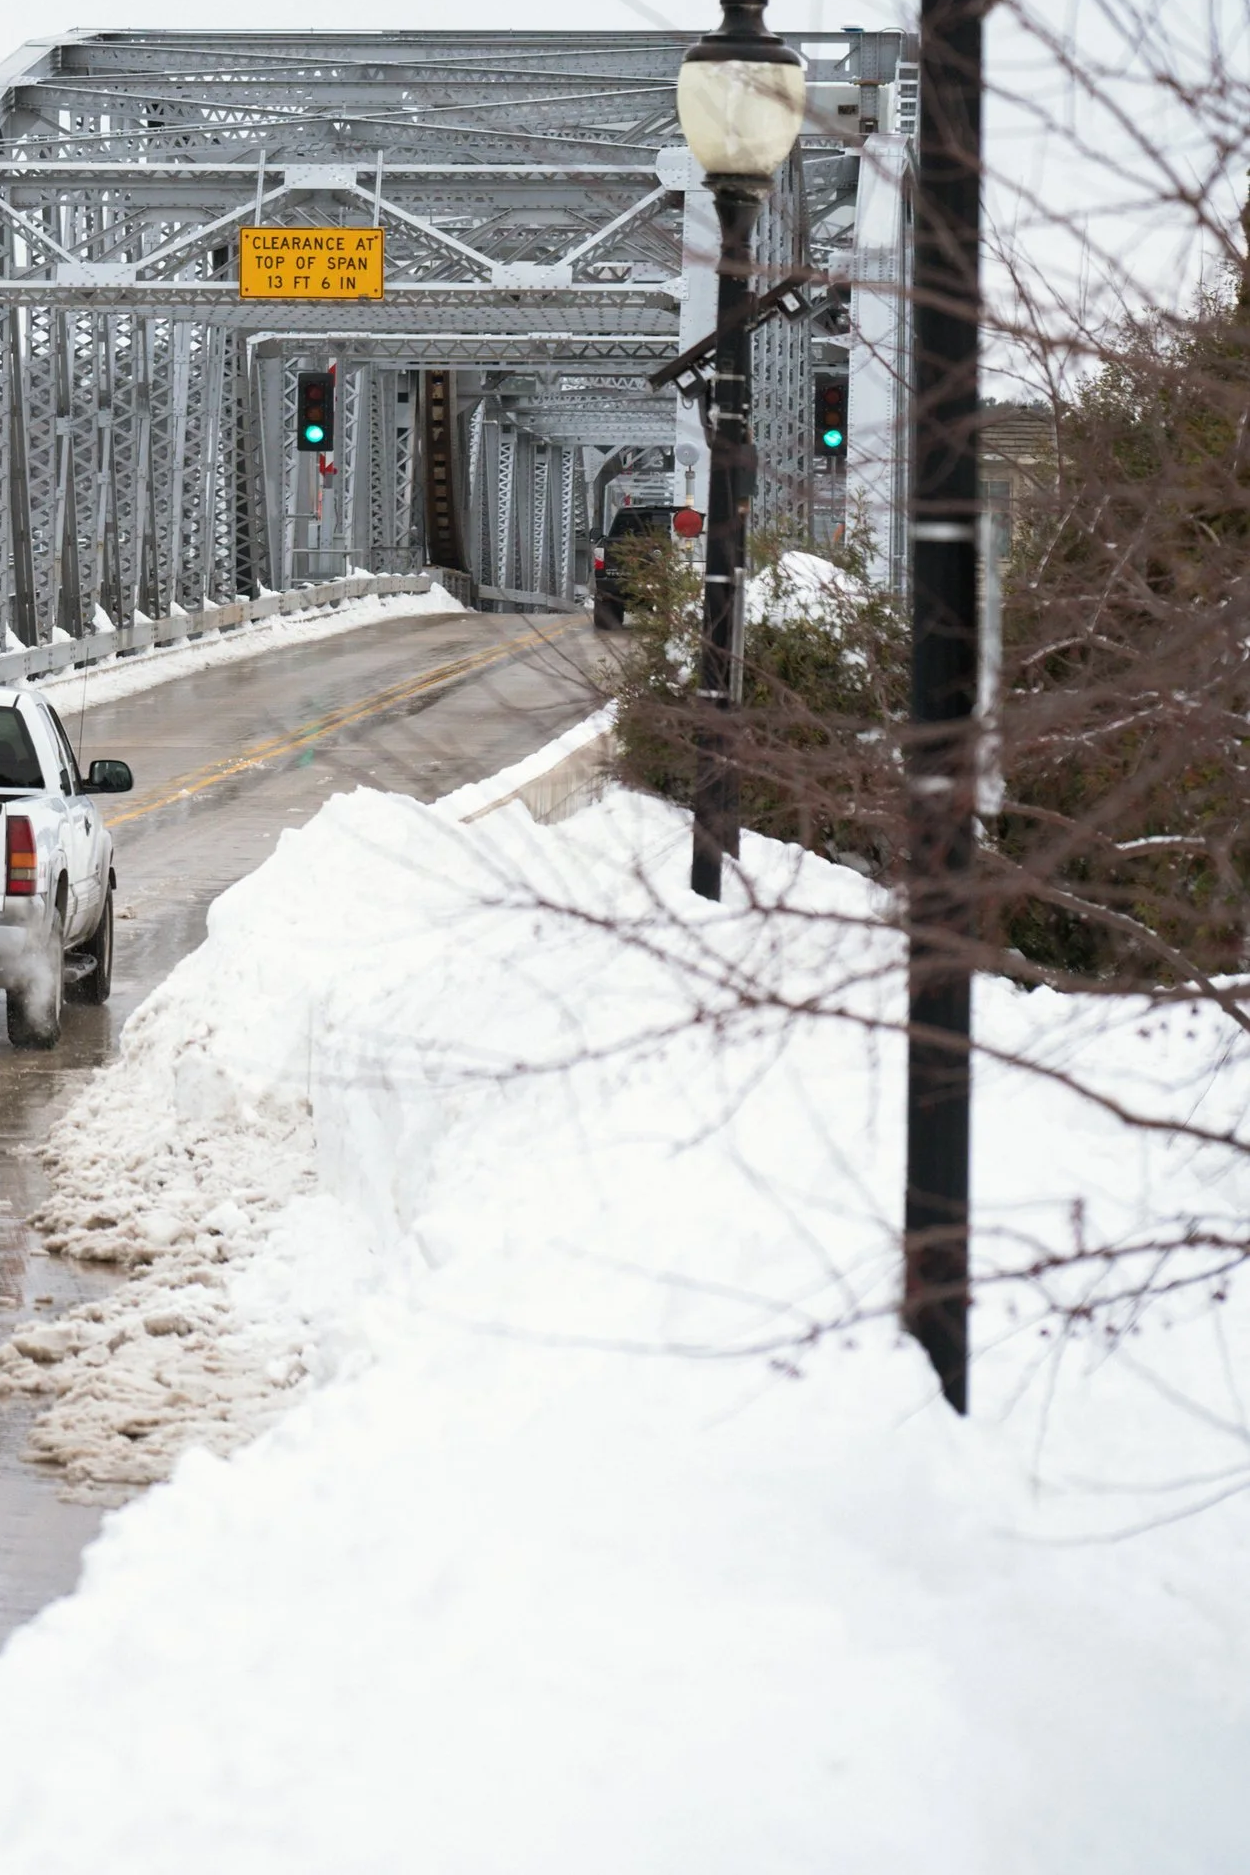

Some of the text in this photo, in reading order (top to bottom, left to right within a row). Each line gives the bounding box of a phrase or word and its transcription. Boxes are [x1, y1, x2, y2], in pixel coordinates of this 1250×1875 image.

[252, 236, 374, 251] CLEARANCE AT
[255, 256, 368, 270] TOP OF SPAN
[267, 276, 356, 289] 13 FT 6 IN
